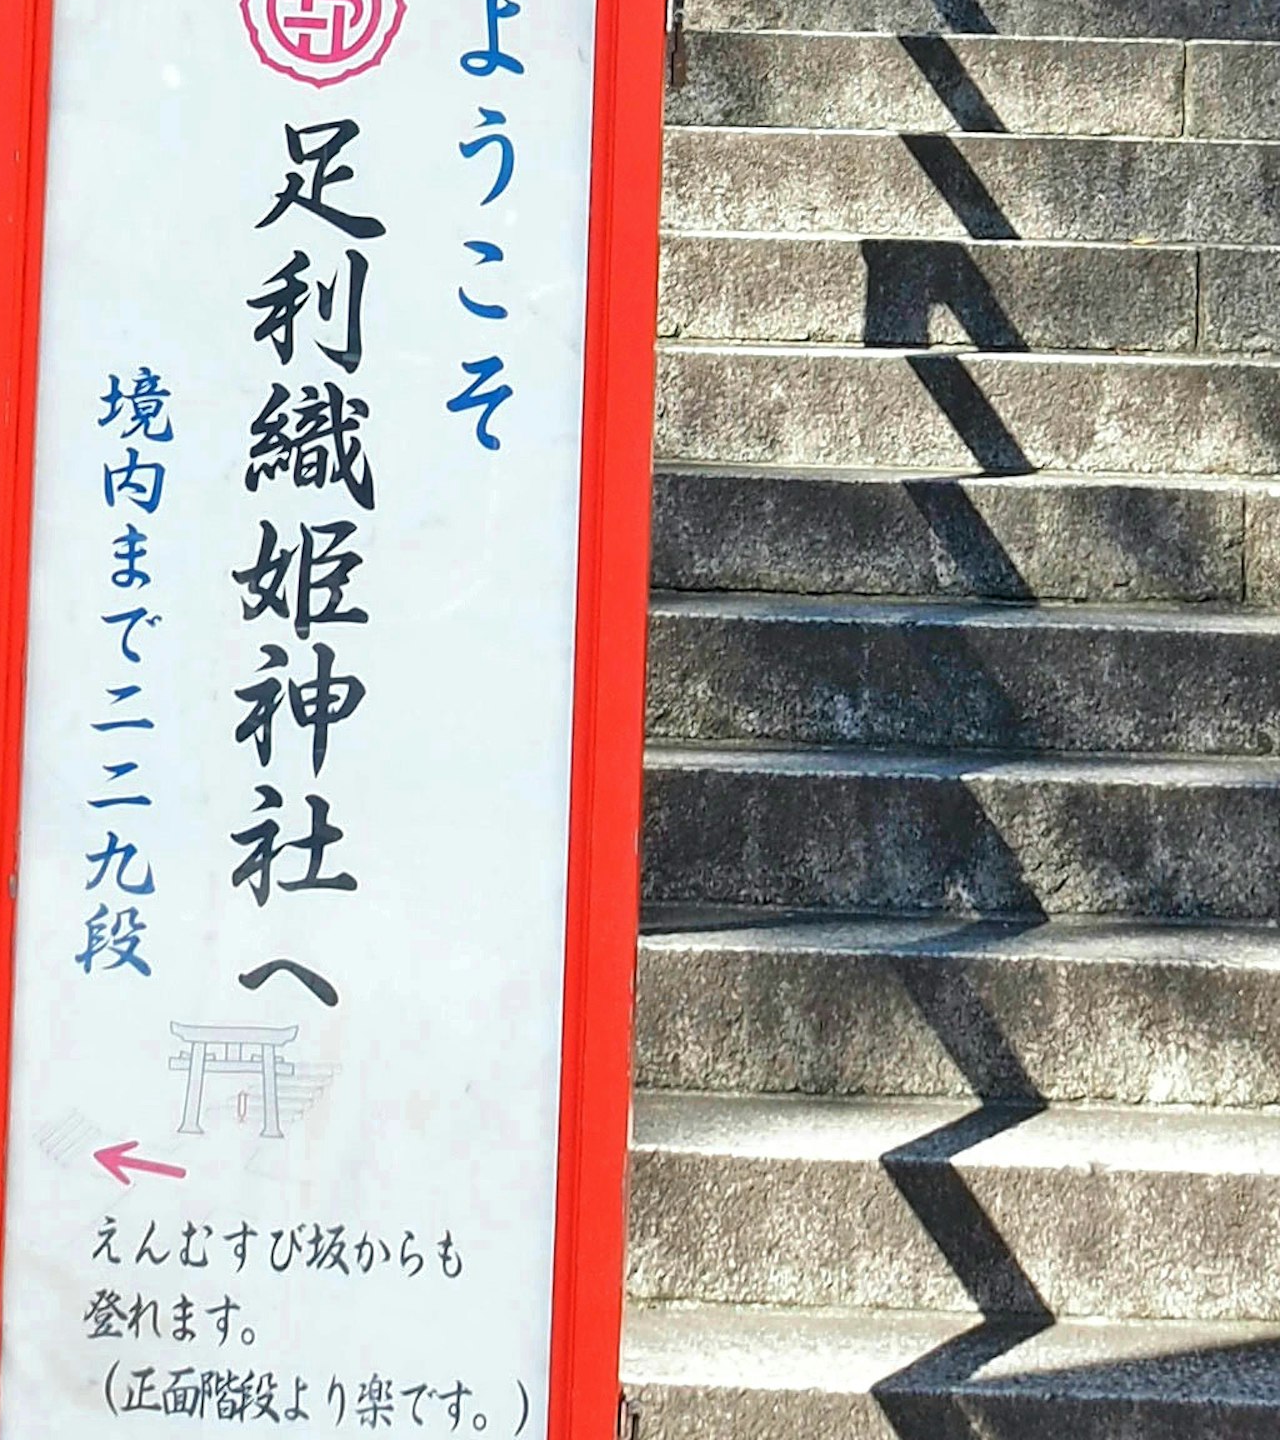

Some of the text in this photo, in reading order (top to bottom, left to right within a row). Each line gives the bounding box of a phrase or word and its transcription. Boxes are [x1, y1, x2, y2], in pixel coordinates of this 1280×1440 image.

[74, 366, 175, 977] 境内まで二二九段
[229, 118, 387, 1008] 足利織姫神社へ
[83, 1288, 256, 1347] 登れます。
[92, 1215, 463, 1279] えんむすび坂からも
